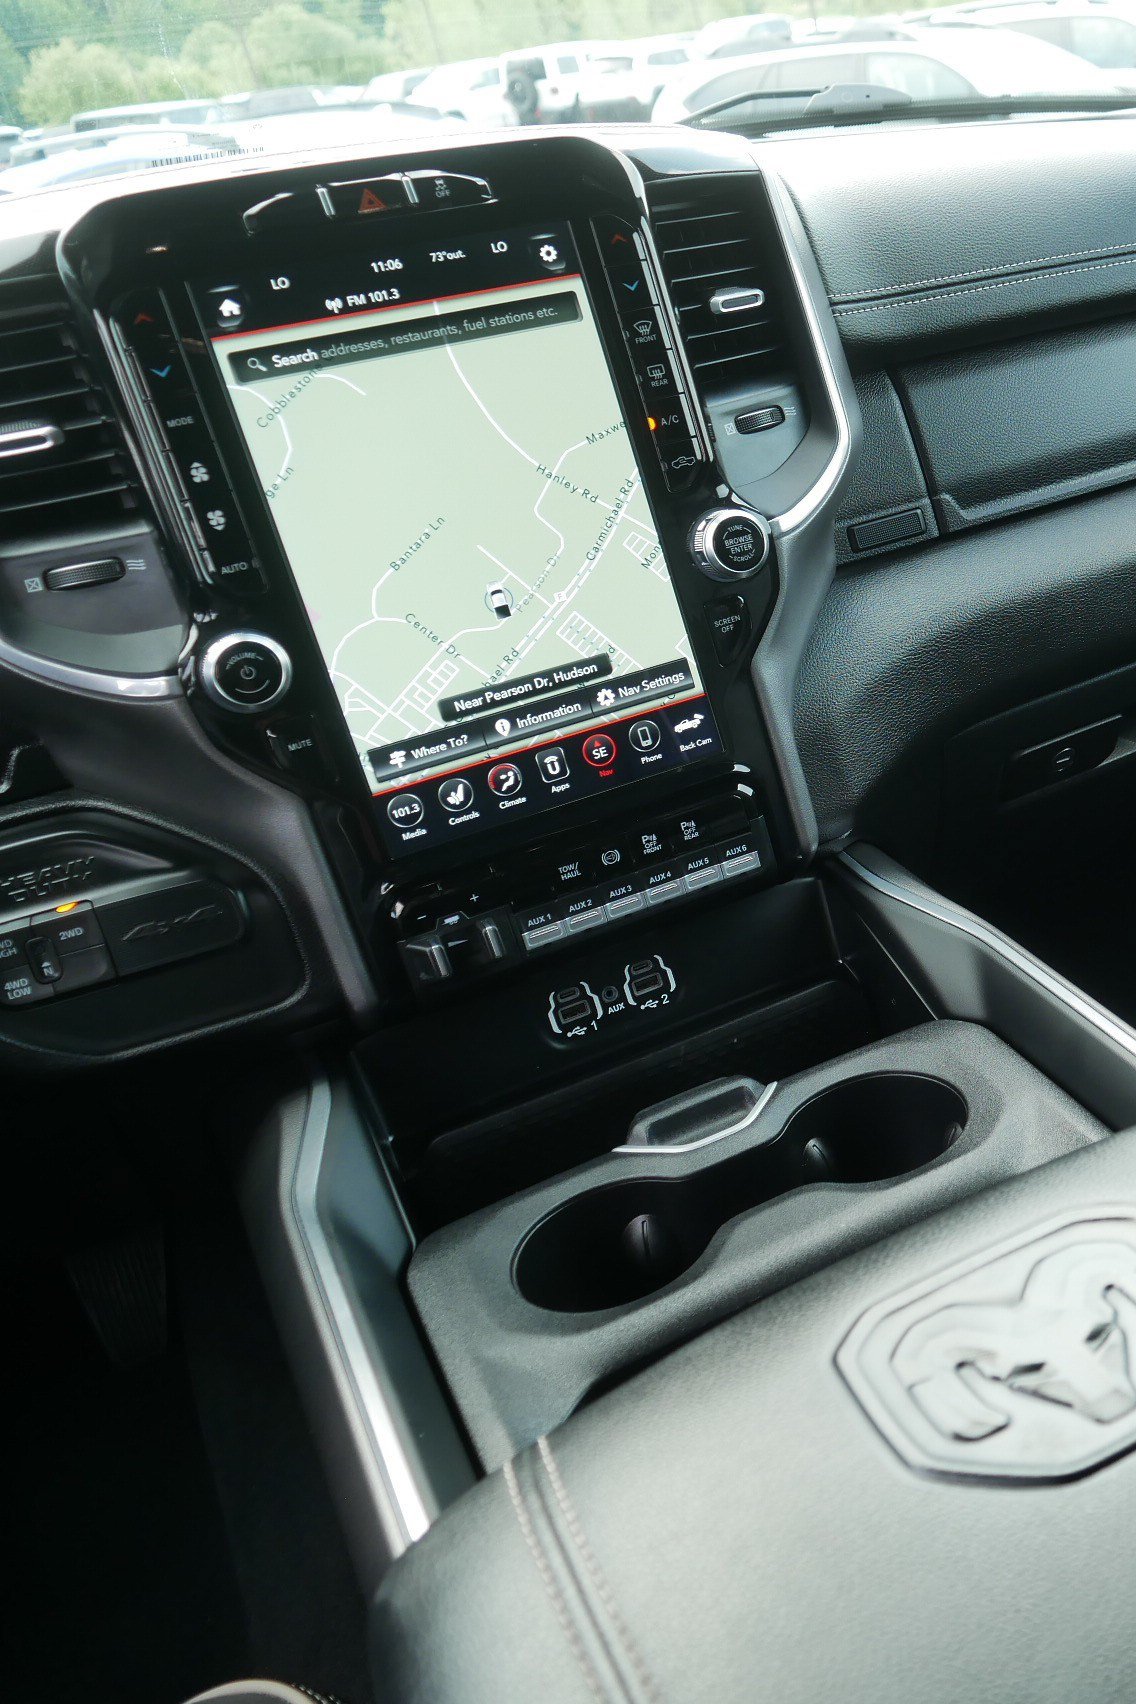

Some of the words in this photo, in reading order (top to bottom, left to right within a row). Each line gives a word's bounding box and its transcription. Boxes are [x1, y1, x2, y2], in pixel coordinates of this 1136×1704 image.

[435, 188, 451, 198] OFF
[490, 241, 508, 254] LO
[371, 258, 403, 273] 11:06
[270, 276, 290, 290] LO
[346, 294, 367, 308] FM
[368, 288, 400, 303] 101.3
[272, 349, 320, 369] Search
[320, 337, 389, 359] addresses,
[390, 322, 463, 345] restaurants,
[463, 316, 487, 333] fuel
[489, 310, 534, 329] stations
[536, 306, 559, 320] etc.
[635, 334, 657, 344] FRONT
[651, 379, 669, 387] REAR
[166, 416, 194, 428] MODE
[661, 414, 680, 427] A/C
[277, 465, 294, 482] Ln
[536, 463, 579, 494] Hanley
[582, 488, 599, 503] Rd
[586, 497, 623, 562] Carmichael
[619, 478, 635, 496] Rd
[727, 525, 744, 533] TUNE
[390, 530, 431, 572] Bantara
[429, 515, 446, 532] Ln
[724, 534, 753, 547] BROWSE
[730, 543, 753, 554] ENTER
[221, 562, 248, 575] AUTO
[714, 614, 741, 628] SCREEN
[721, 624, 735, 634] OFF
[405, 613, 444, 647] Center
[445, 644, 462, 660] Dr
[229, 651, 257, 666] VOLUME
[502, 648, 520, 665] Rd
[454, 694, 485, 713] Near
[485, 681, 533, 705] Pearson
[553, 663, 598, 684] Hudson
[618, 686, 641, 698] Nav
[641, 671, 685, 692] Settings
[516, 702, 582, 729] Information
[287, 738, 312, 752] MUTE
[411, 743, 448, 760] Where
[447, 734, 469, 749] To?
[697, 736, 713, 748] Cam
[592, 746, 609, 759] SE
[641, 753, 663, 765] Phone
[599, 768, 614, 777] Nav
[551, 781, 571, 794] Apps
[499, 795, 528, 810] Climate
[391, 803, 421, 819] 101.3
[449, 811, 480, 827] Controls
[402, 827, 428, 841] Media
[726, 847, 741, 857] AUX
[741, 844, 748, 852] 6
[558, 861, 579, 877] TOW/
[688, 859, 704, 871] AUX
[704, 857, 710, 865] 5
[560, 868, 582, 882] HAUL
[649, 873, 666, 885] AUX
[667, 870, 672, 879] 4
[609, 887, 627, 898] AUX
[627, 884, 633, 892] 3
[569, 901, 586, 913] AUX
[586, 898, 593, 907] 2
[527, 915, 545, 928] AUX
[546, 913, 552, 921] 1
[59, 926, 84, 940] 2WD
[43, 967, 54, 977] N
[4, 977, 28, 991] 4WD
[7, 986, 32, 1000] LOW
[661, 994, 670, 1005] 2
[607, 1002, 626, 1015] AUX
[591, 1020, 598, 1031] 1
